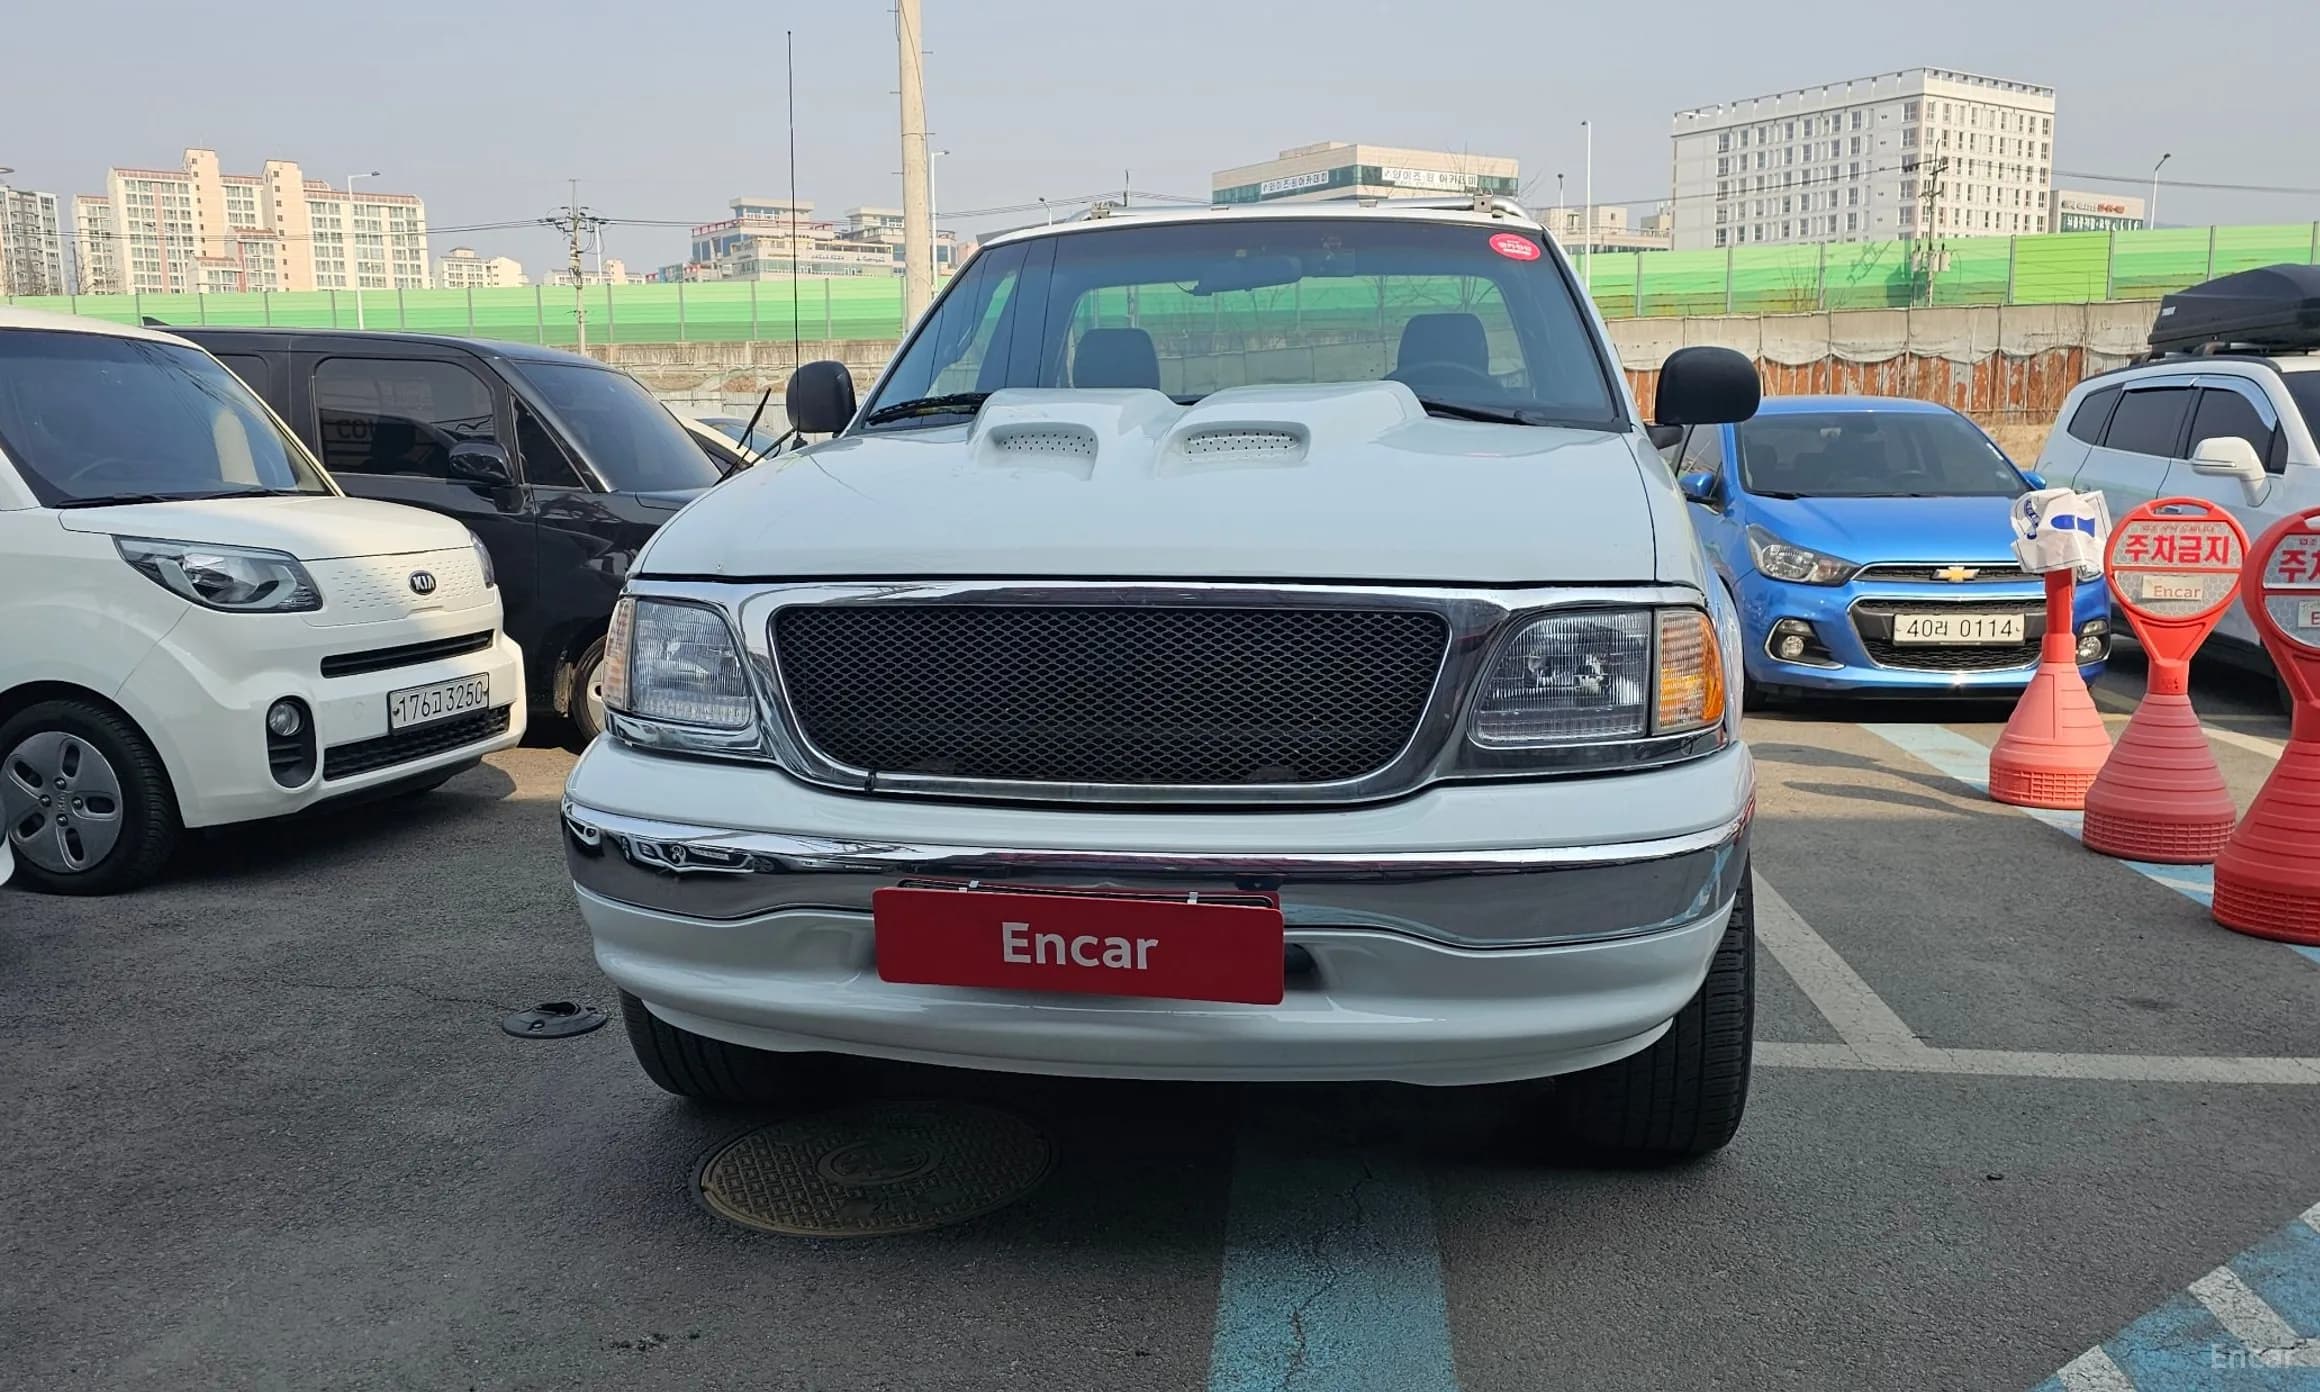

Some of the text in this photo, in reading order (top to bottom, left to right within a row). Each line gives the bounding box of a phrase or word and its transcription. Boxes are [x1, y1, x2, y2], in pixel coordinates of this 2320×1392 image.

[2125, 534, 2230, 565] 주차금지
[412, 575, 436, 590] KIA
[2153, 585, 2201, 598] Encar
[1960, 619, 2013, 638] 0114
[446, 680, 483, 712] 3250
[1002, 921, 1159, 970] Encar
